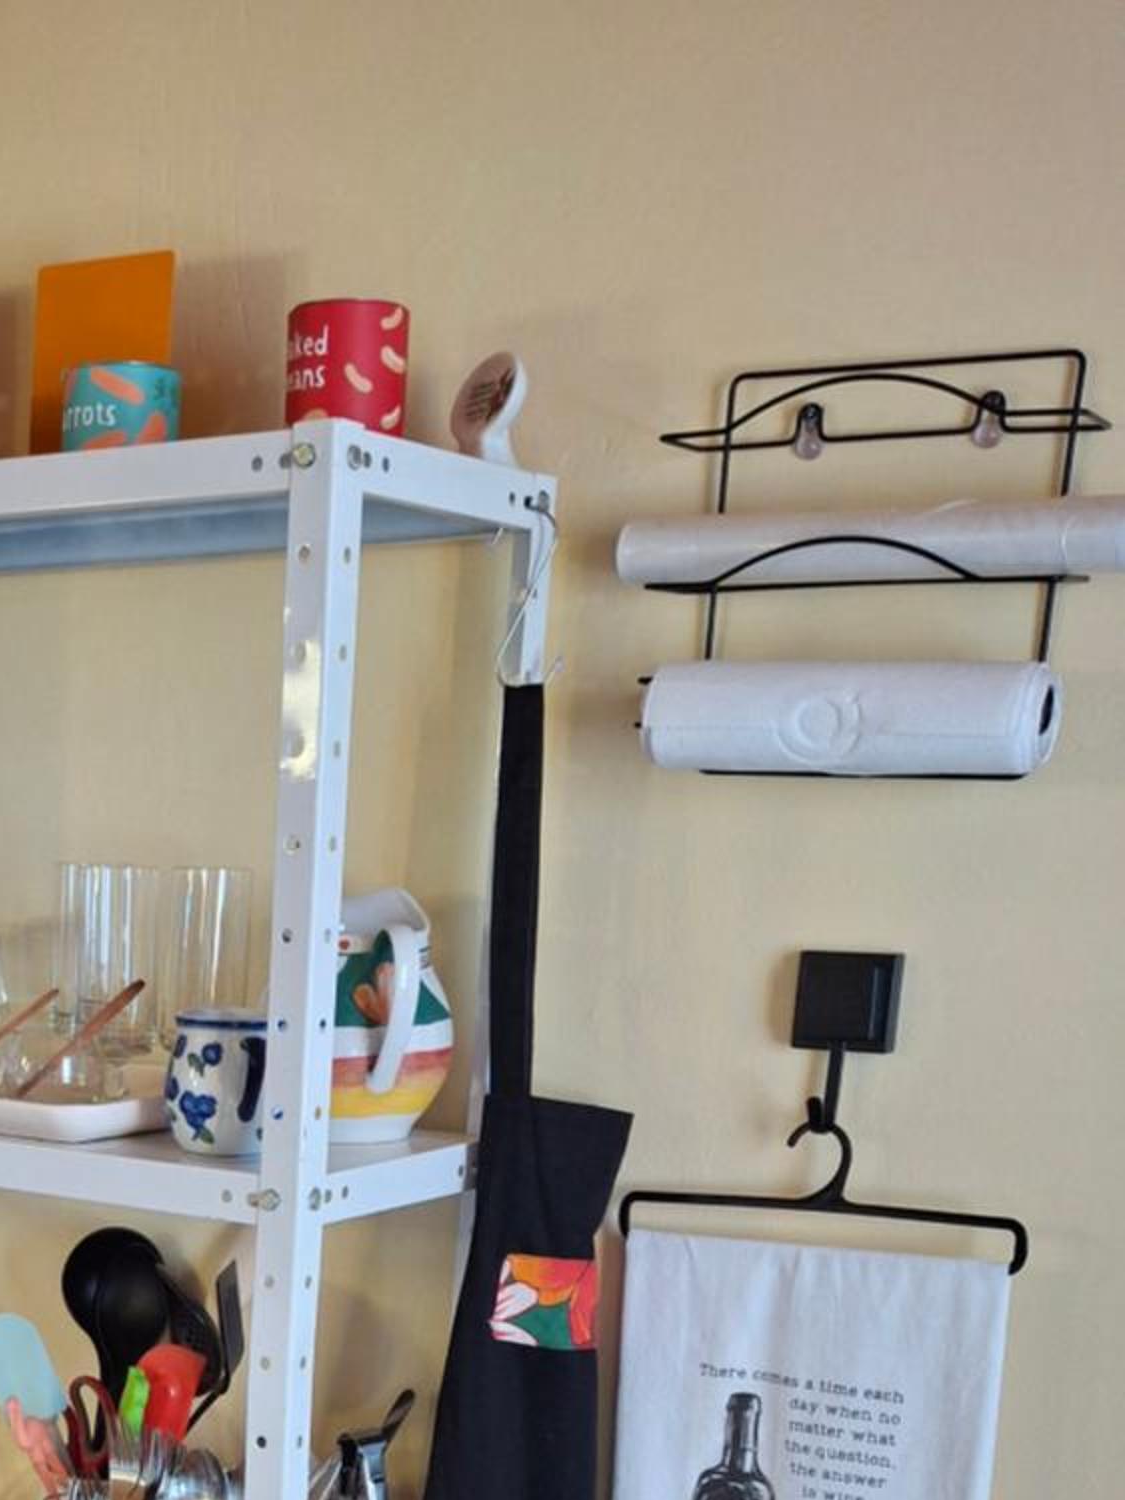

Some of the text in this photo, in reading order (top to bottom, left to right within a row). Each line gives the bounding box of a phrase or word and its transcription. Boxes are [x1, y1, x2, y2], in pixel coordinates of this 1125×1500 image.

[699, 1363, 905, 1405] There comes a time each
[789, 1397, 902, 1426] day when no
[784, 1438, 811, 1455] the
[788, 1419, 897, 1447] matter what
[790, 1461, 888, 1489] the answer
[801, 1485, 817, 1499] is
